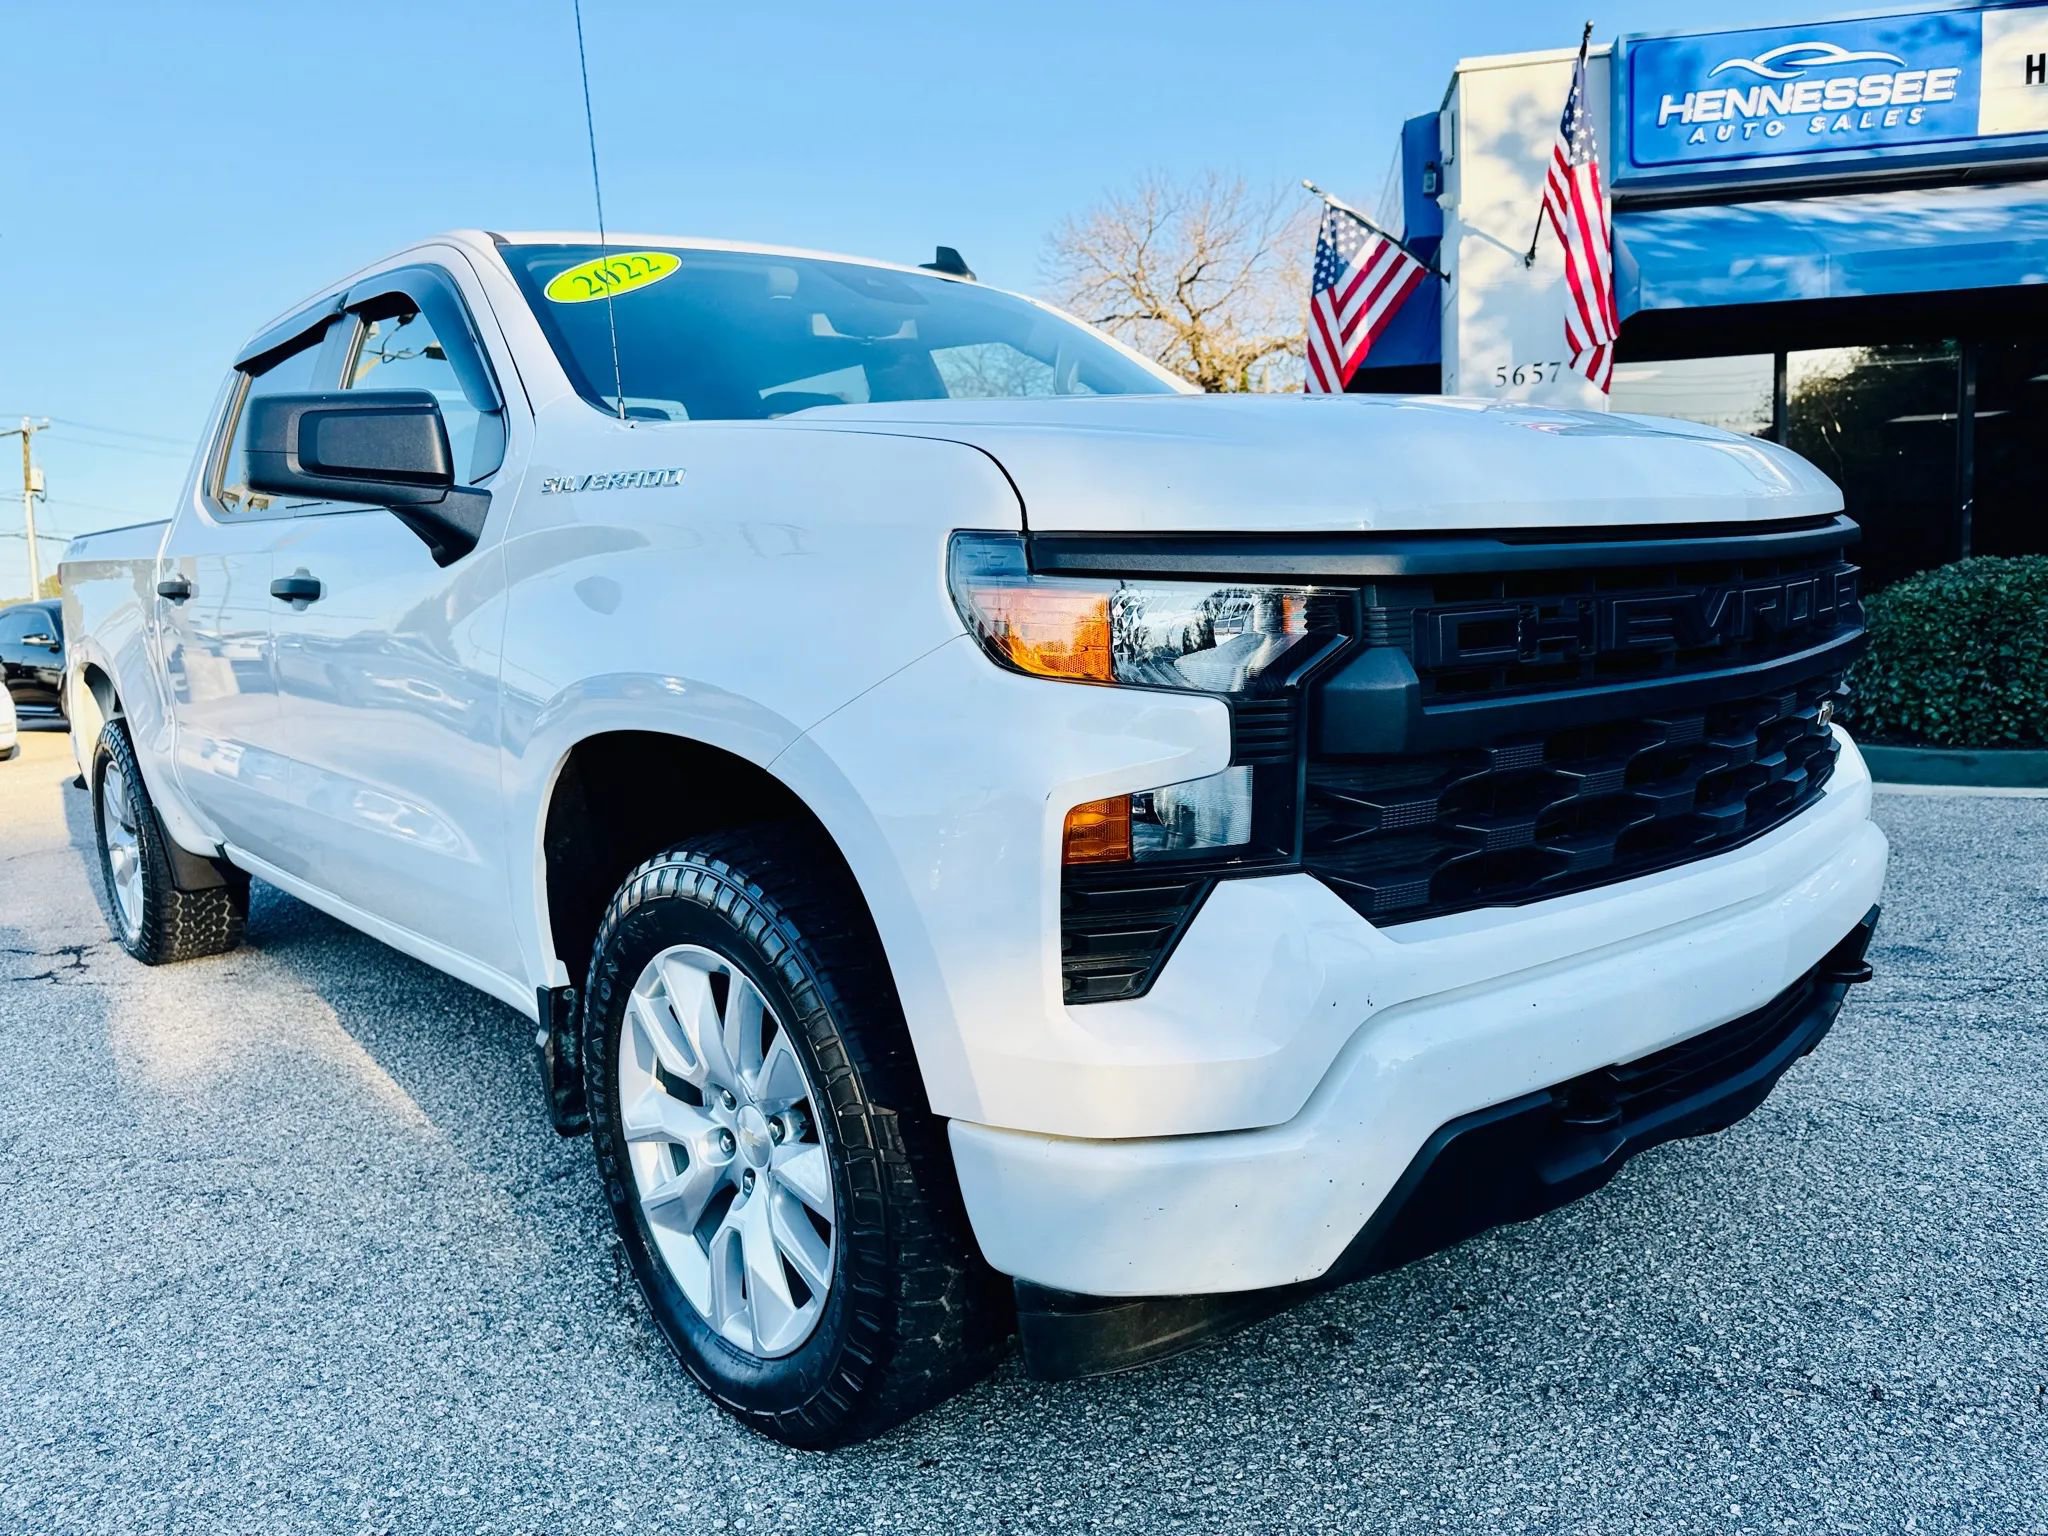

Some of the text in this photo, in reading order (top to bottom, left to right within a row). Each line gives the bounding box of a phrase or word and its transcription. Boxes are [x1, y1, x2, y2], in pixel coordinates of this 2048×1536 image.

[1657, 68, 1960, 126] HENNESSEE
[1688, 107, 1926, 144] AUTO SALES
[572, 256, 661, 295] 2022
[1495, 361, 1562, 388] 5657
[541, 468, 686, 495] SILVERADO
